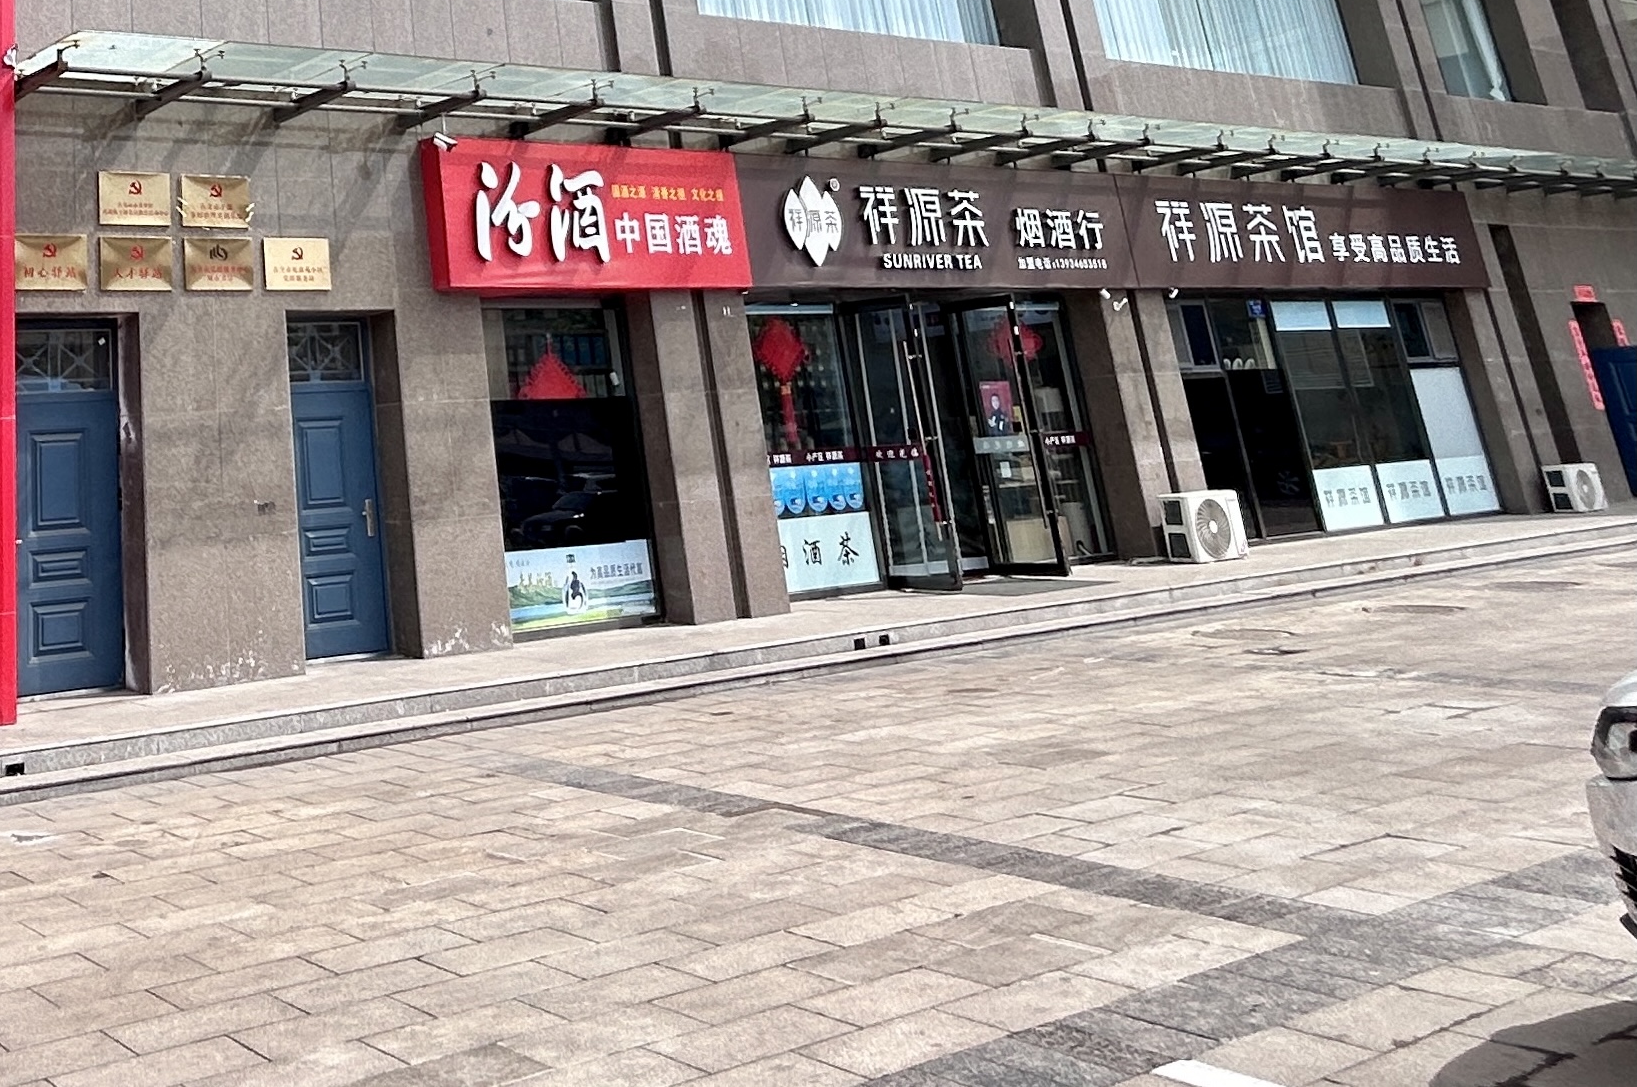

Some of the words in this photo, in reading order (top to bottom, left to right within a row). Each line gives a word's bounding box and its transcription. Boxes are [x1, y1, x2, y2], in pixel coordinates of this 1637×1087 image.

[475, 161, 611, 263] 汾酒
[615, 211, 733, 256] 中国酒魂
[788, 208, 839, 234] 祥源茶
[859, 186, 990, 247] 祥源茶
[1015, 208, 1104, 251] 烟酒行
[1154, 199, 1327, 264] 祥源茶馆
[884, 254, 954, 270] SUNRIVER
[956, 255, 983, 270] TEA
[1328, 232, 1462, 264] 享受高品质生活
